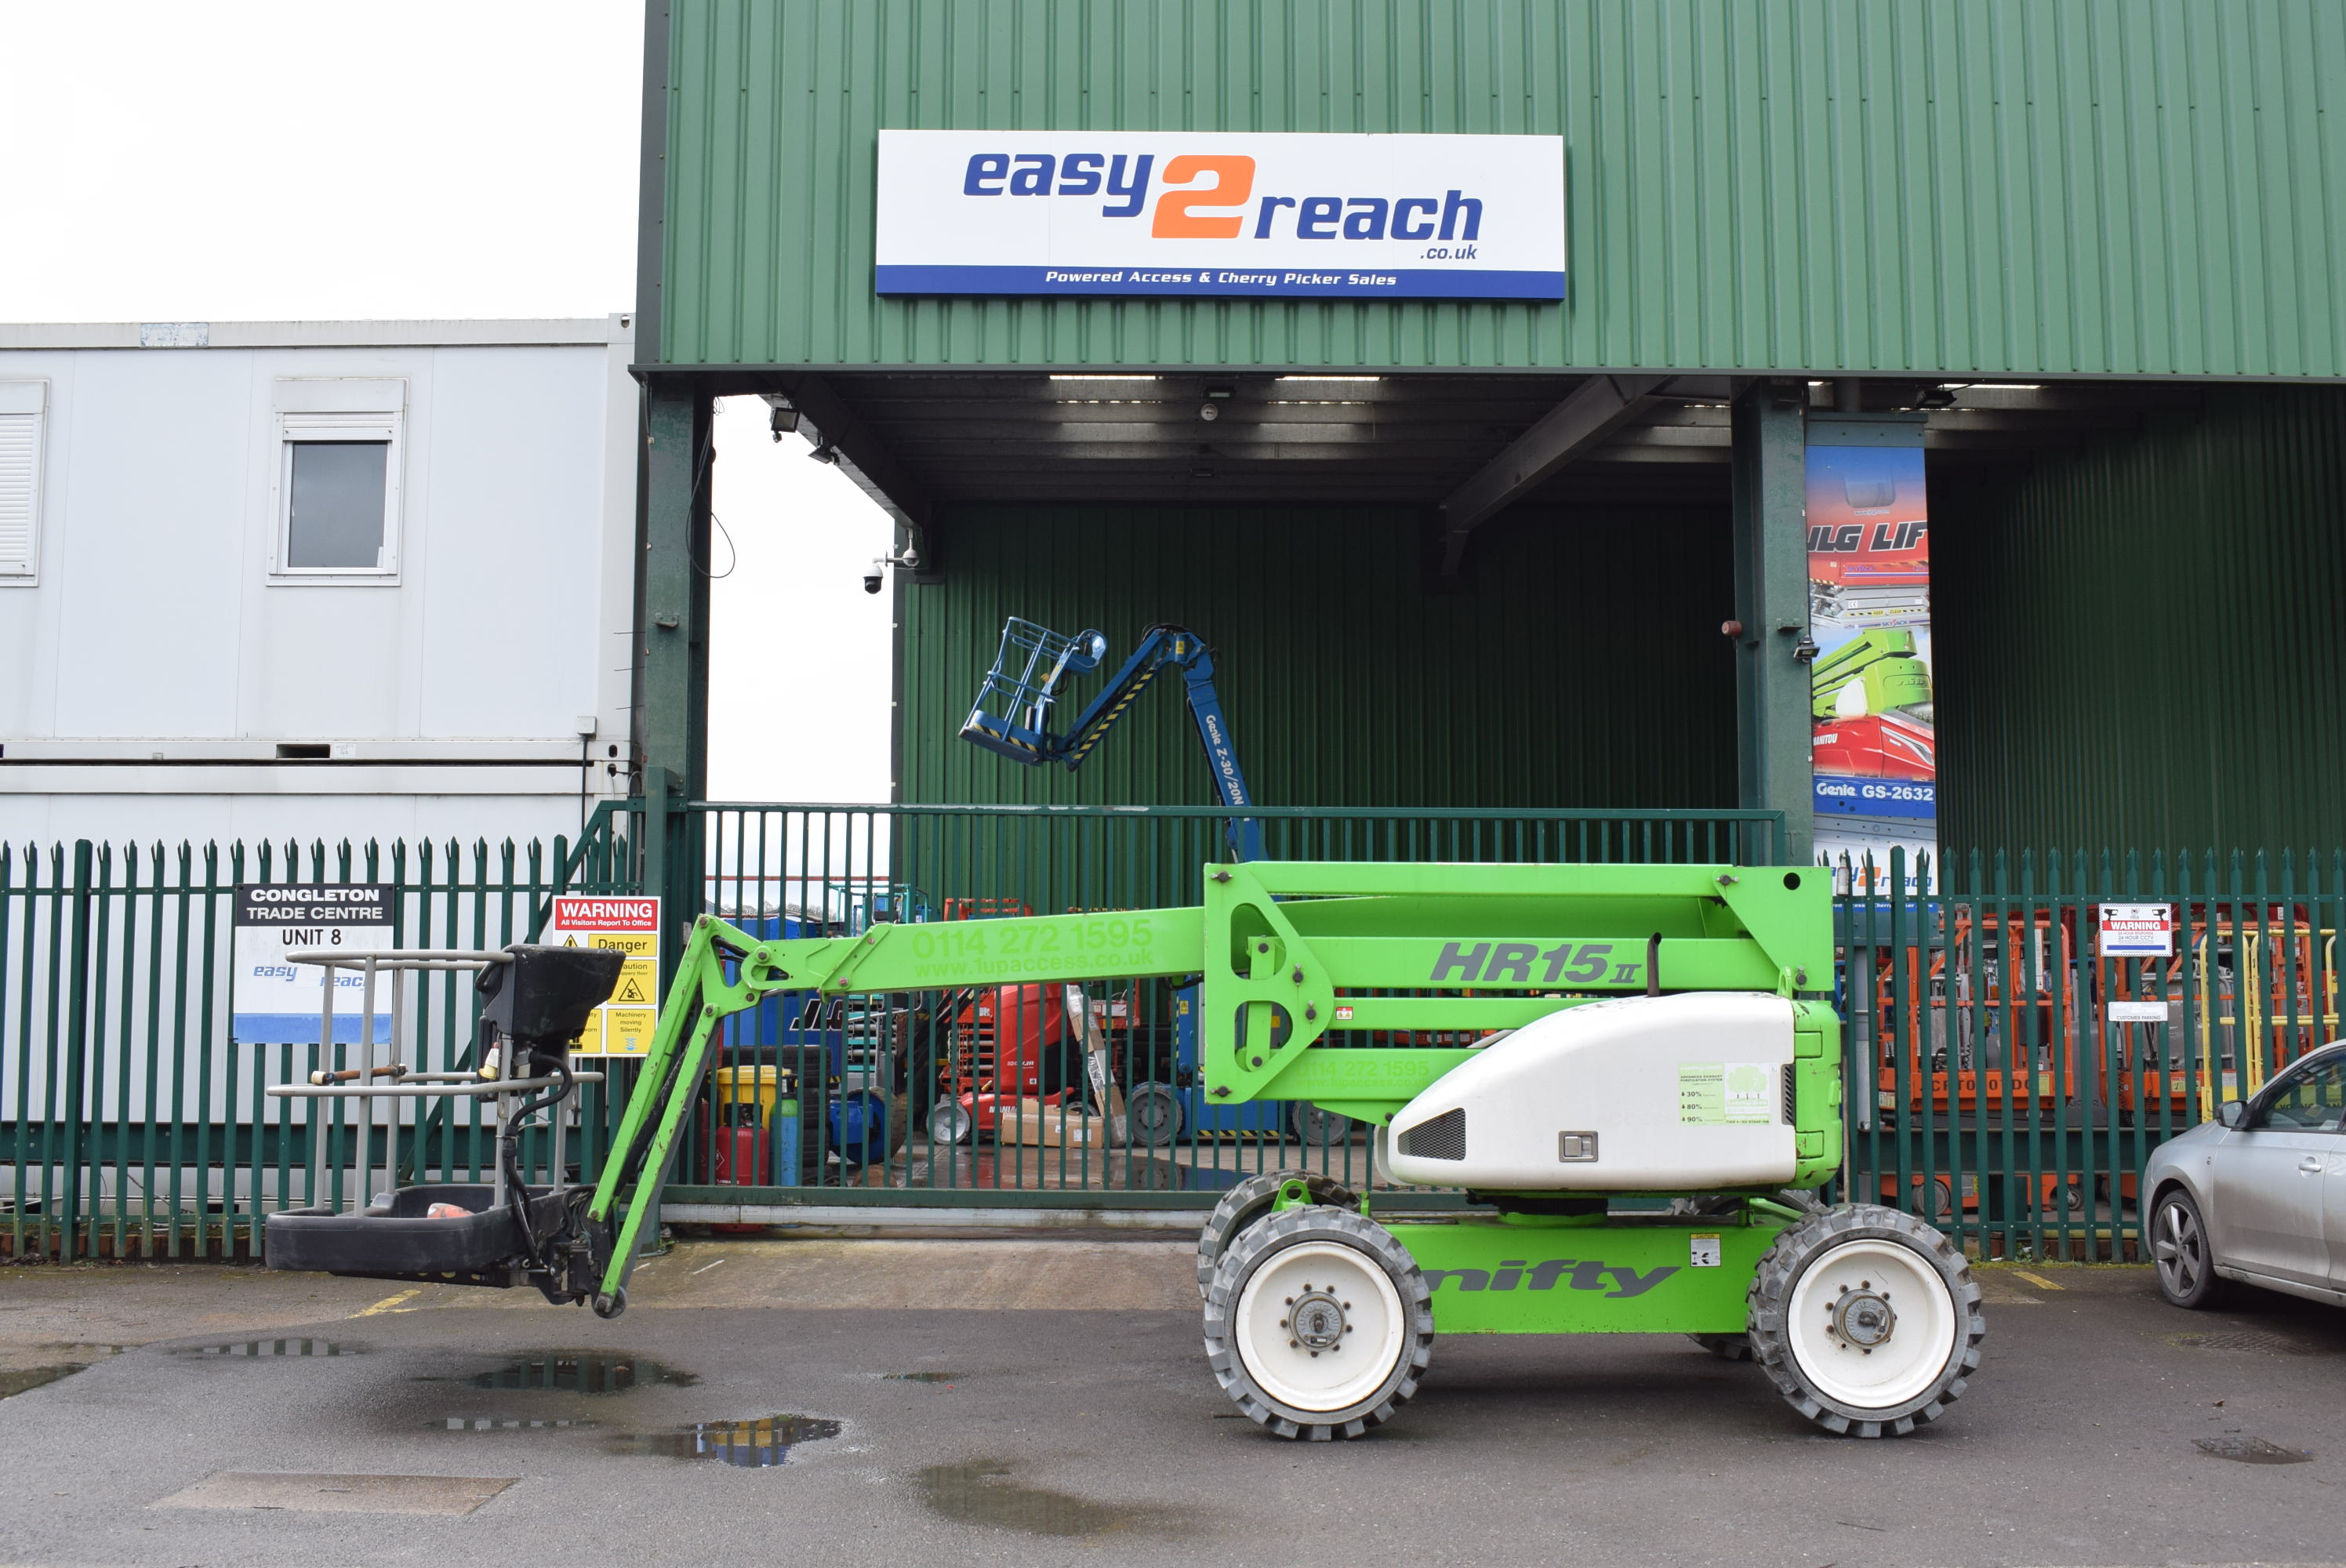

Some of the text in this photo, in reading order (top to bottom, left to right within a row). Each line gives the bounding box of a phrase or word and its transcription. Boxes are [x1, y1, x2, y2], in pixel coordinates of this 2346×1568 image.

[1420, 245, 1478, 260] .co.uk
[1045, 270, 1396, 286] Powered Access & Cherry Picker Sales
[1206, 714, 1244, 805] Genie Z-30/20N
[1816, 782, 1934, 801] Genie GS-2632
[251, 889, 380, 902] CONGLETON
[246, 907, 383, 920] TRADE CENTRE
[561, 902, 652, 918] WARNING
[2111, 921, 2161, 931] WARNING
[282, 929, 342, 946] UNIT 8
[598, 938, 648, 953] Danger
[913, 919, 1153, 959] 0114 272 1595
[914, 947, 1153, 978] www.1upaccess.co.uk
[1429, 942, 1613, 983] HR15
[253, 966, 365, 988] easy reac
[1345, 1061, 1378, 1076] 272
[1384, 1061, 1429, 1076] 1595
[1421, 1259, 1683, 1298] nifty
